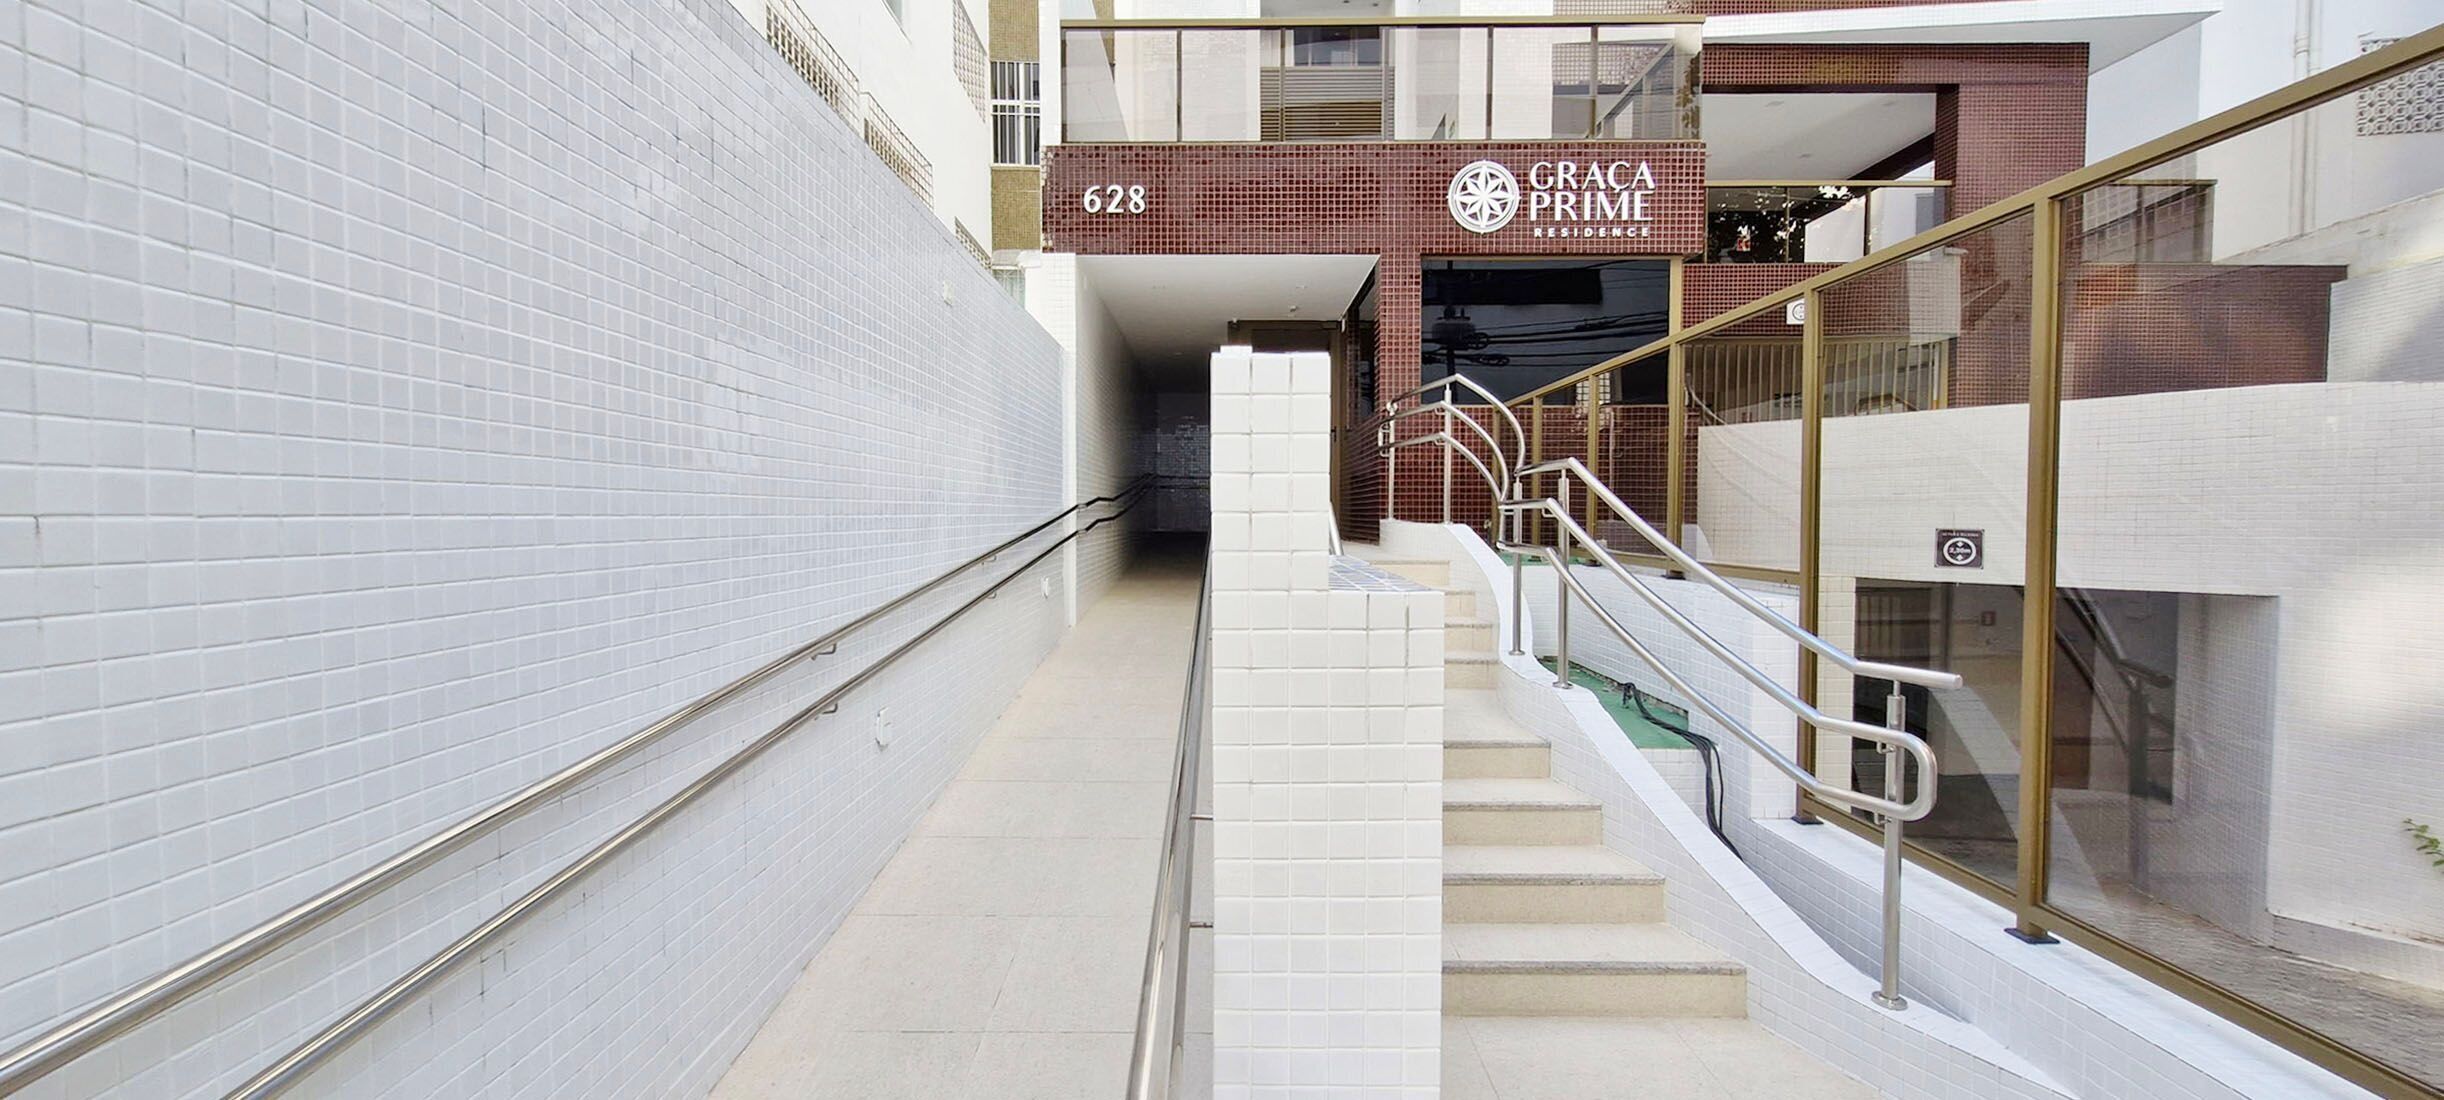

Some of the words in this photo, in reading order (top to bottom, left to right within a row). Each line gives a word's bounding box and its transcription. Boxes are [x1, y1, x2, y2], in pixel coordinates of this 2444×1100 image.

[1529, 160, 1656, 193] GRAÇA
[1083, 184, 1146, 214] 628
[1529, 190, 1655, 222] PRIME
[1533, 227, 1650, 238] RESIDENCE
